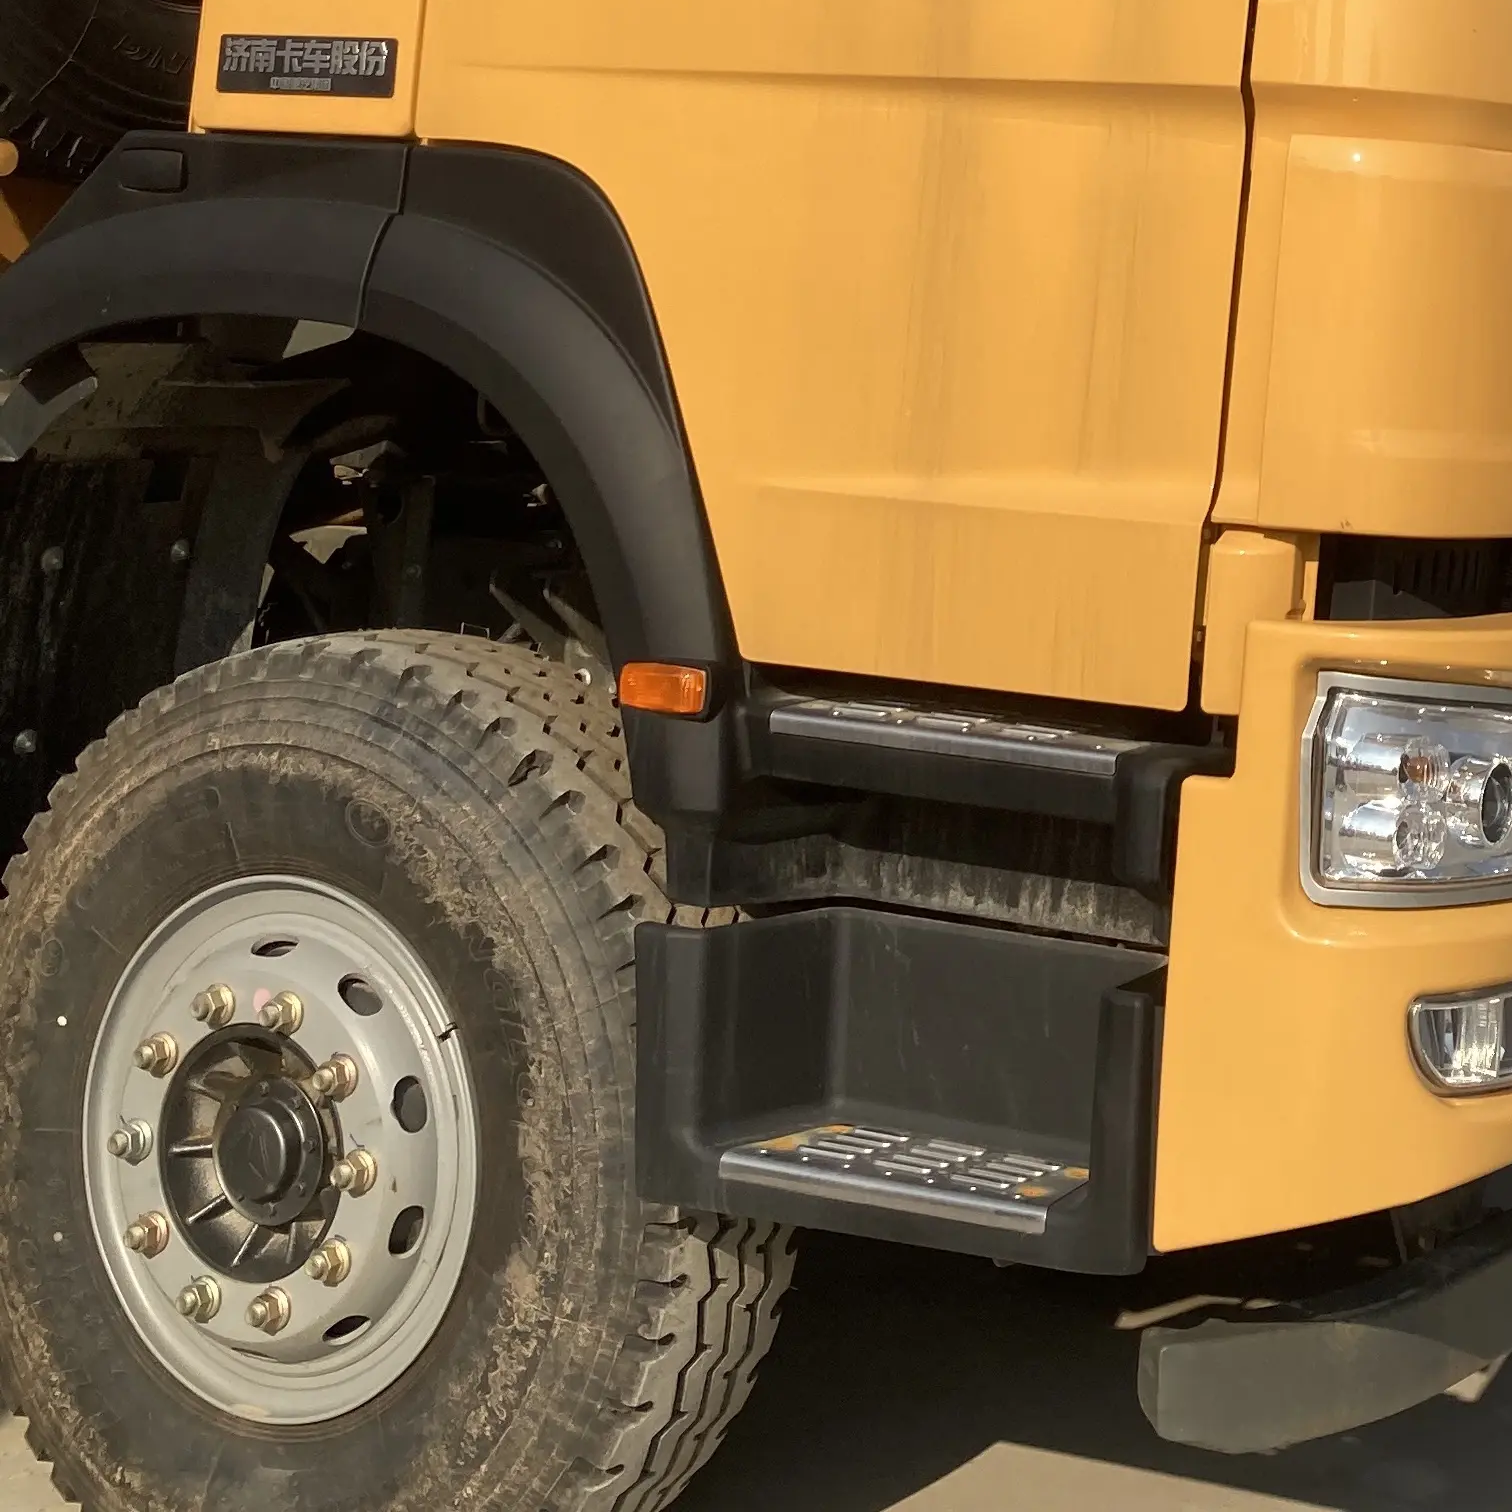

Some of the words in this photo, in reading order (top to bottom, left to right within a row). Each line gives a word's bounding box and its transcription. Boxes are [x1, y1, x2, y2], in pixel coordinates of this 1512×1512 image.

[222, 37, 389, 77] 济南卡车股份
